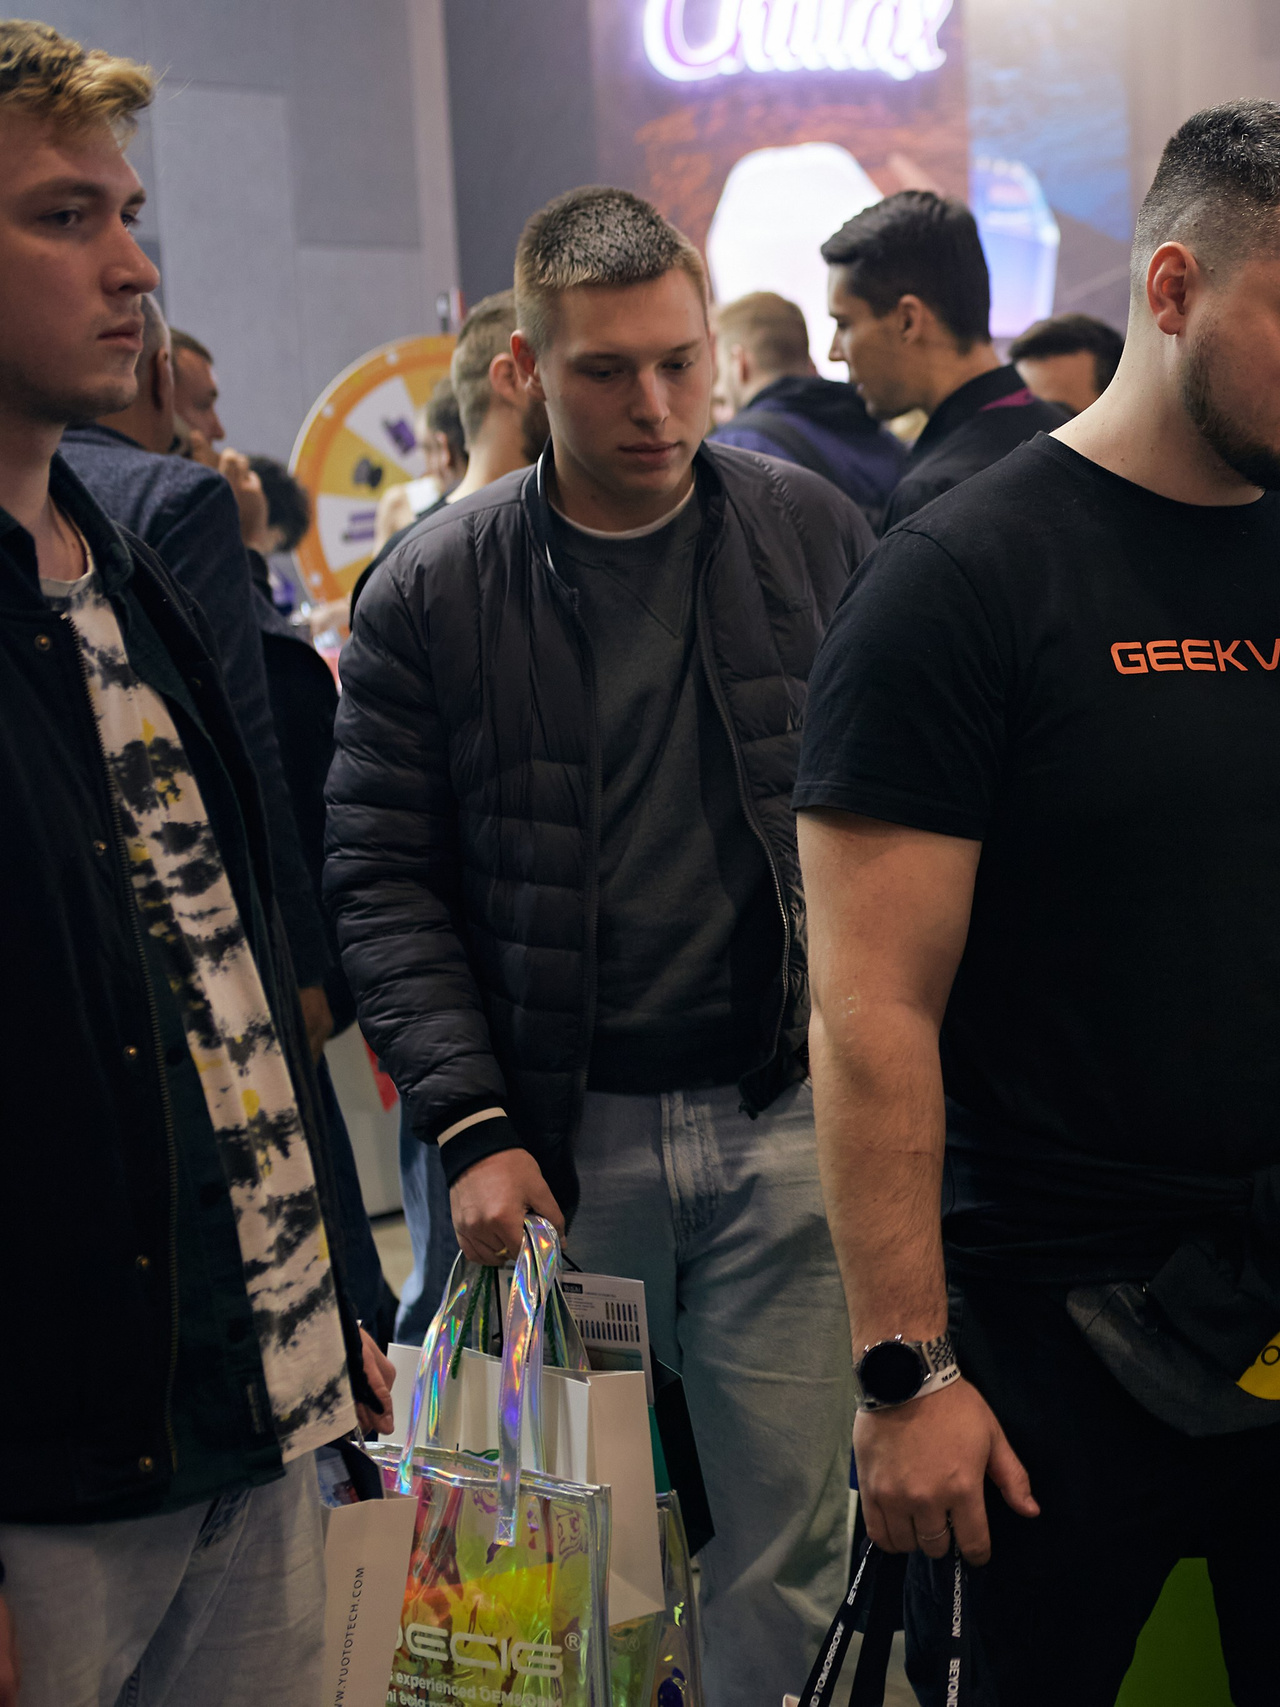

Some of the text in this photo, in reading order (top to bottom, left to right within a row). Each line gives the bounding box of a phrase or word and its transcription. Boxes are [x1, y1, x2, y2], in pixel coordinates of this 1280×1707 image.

[952, 1560, 962, 1638] TOMORROW
[396, 1622, 564, 1678] ECIG
[813, 1620, 845, 1694] TOMORROW
[396, 1671, 478, 1701] experienced
